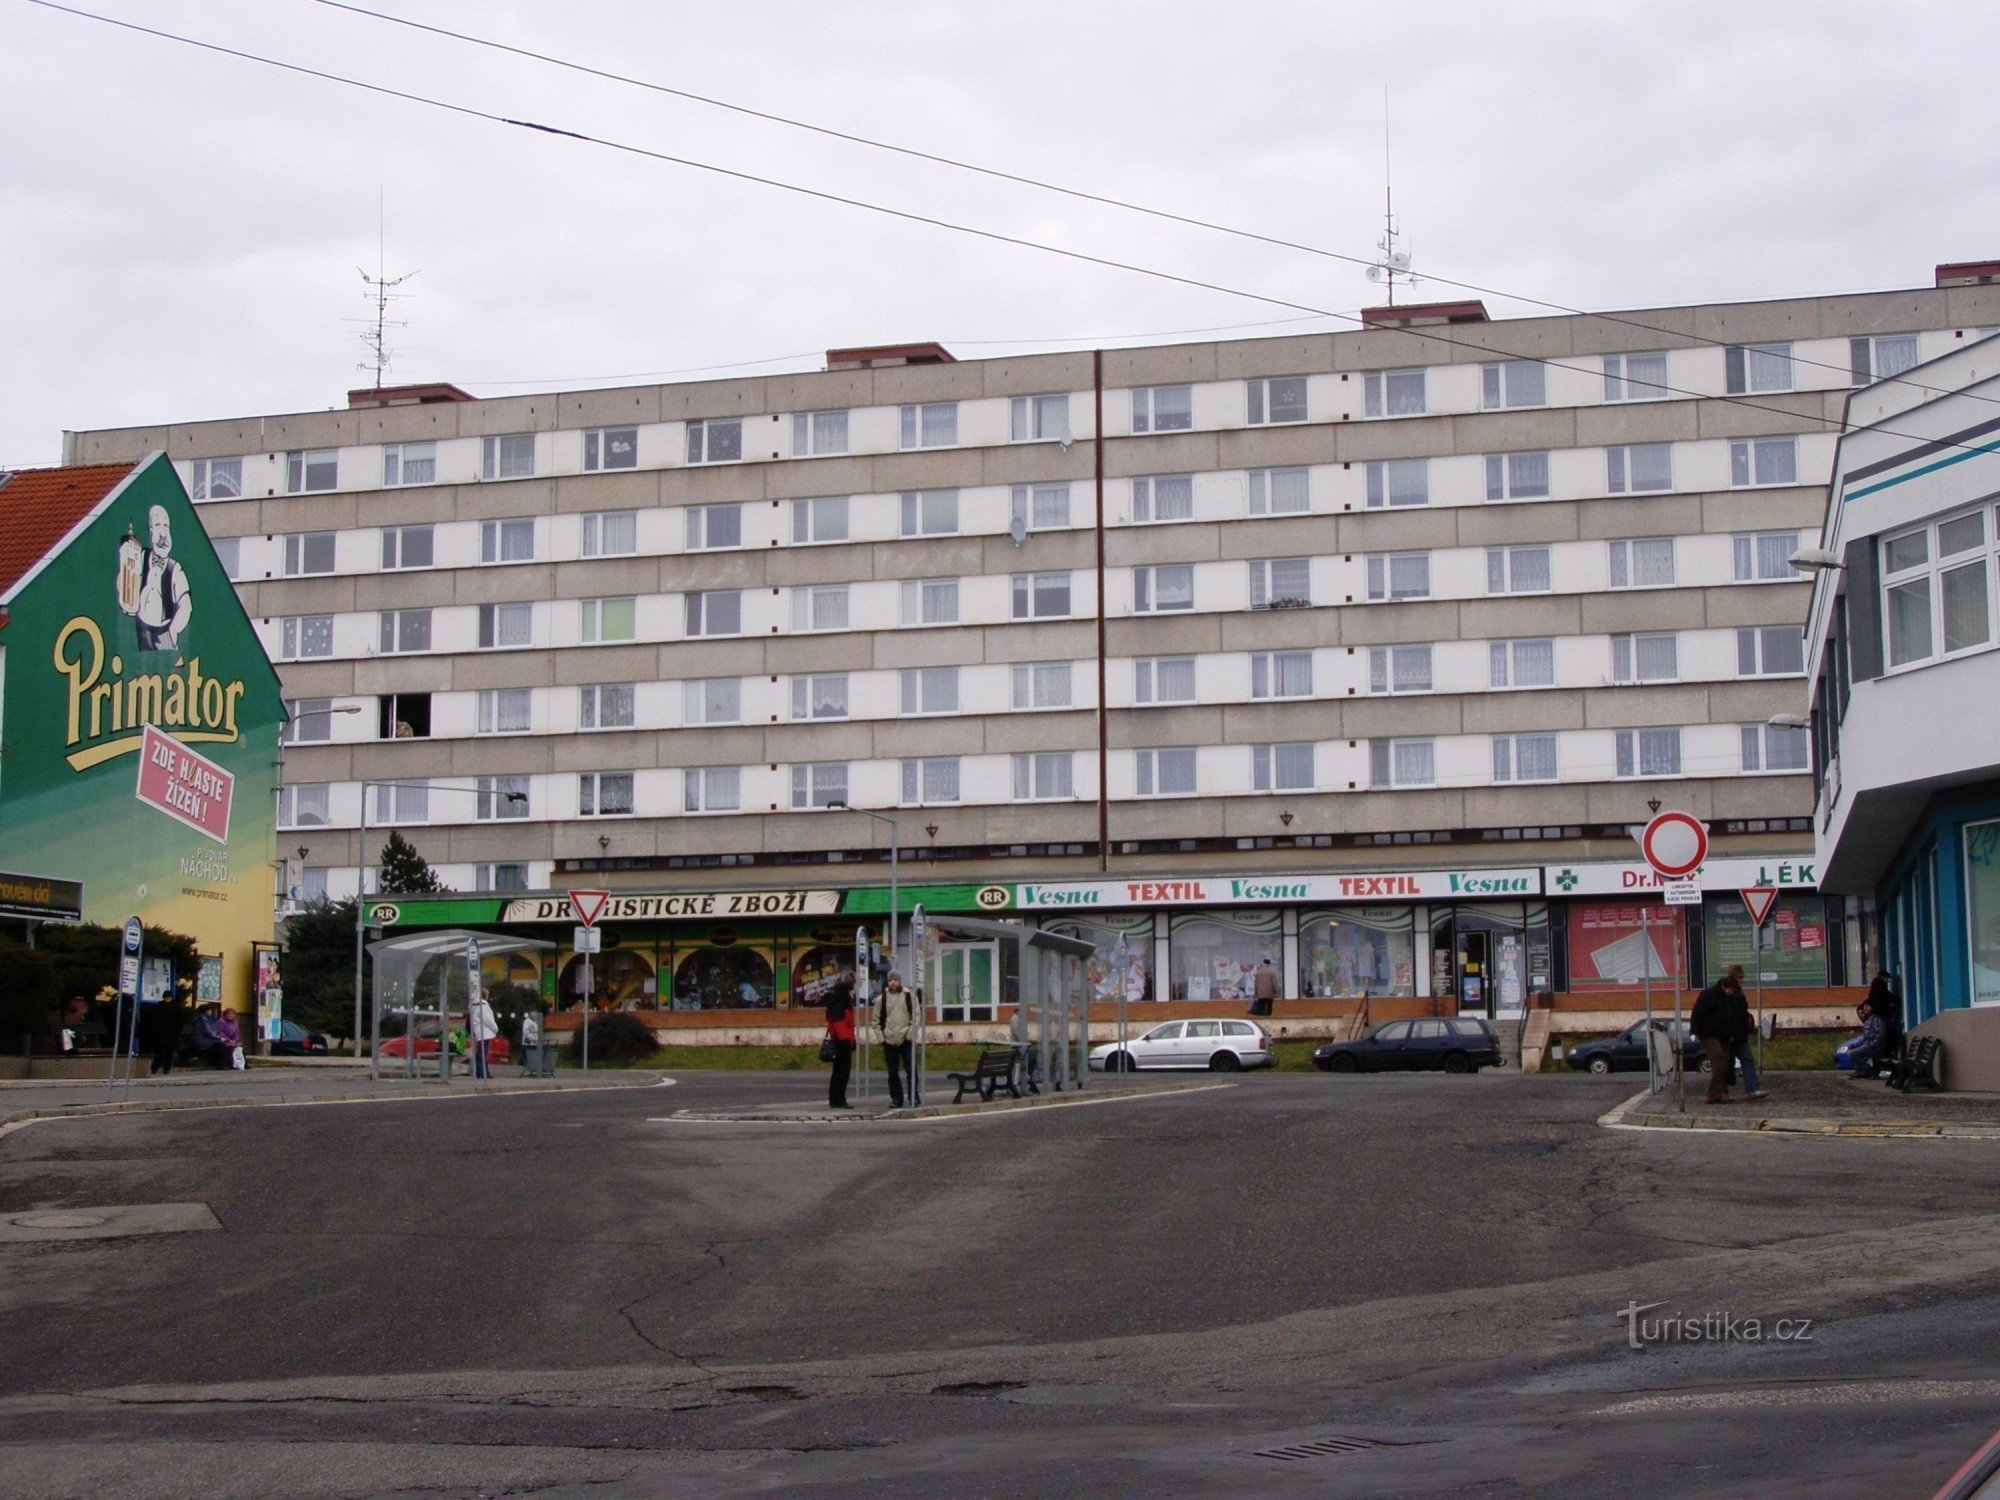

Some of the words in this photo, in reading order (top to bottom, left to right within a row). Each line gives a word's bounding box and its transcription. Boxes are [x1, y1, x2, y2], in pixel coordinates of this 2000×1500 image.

[54, 616, 245, 748] Primátor
[151, 740, 177, 773] ZDE
[181, 855, 228, 882] NÁCHOD
[1127, 883, 1206, 901] TEXTIL
[1231, 879, 1308, 899] Vesna
[1339, 877, 1420, 896] TEXTIL
[1448, 873, 1528, 893] Vesna
[728, 891, 808, 912] ZBOŽÍ
[983, 891, 1002, 904] RR
[1024, 885, 1100, 905] Vesna
[1362, 909, 1392, 917] Vesna
